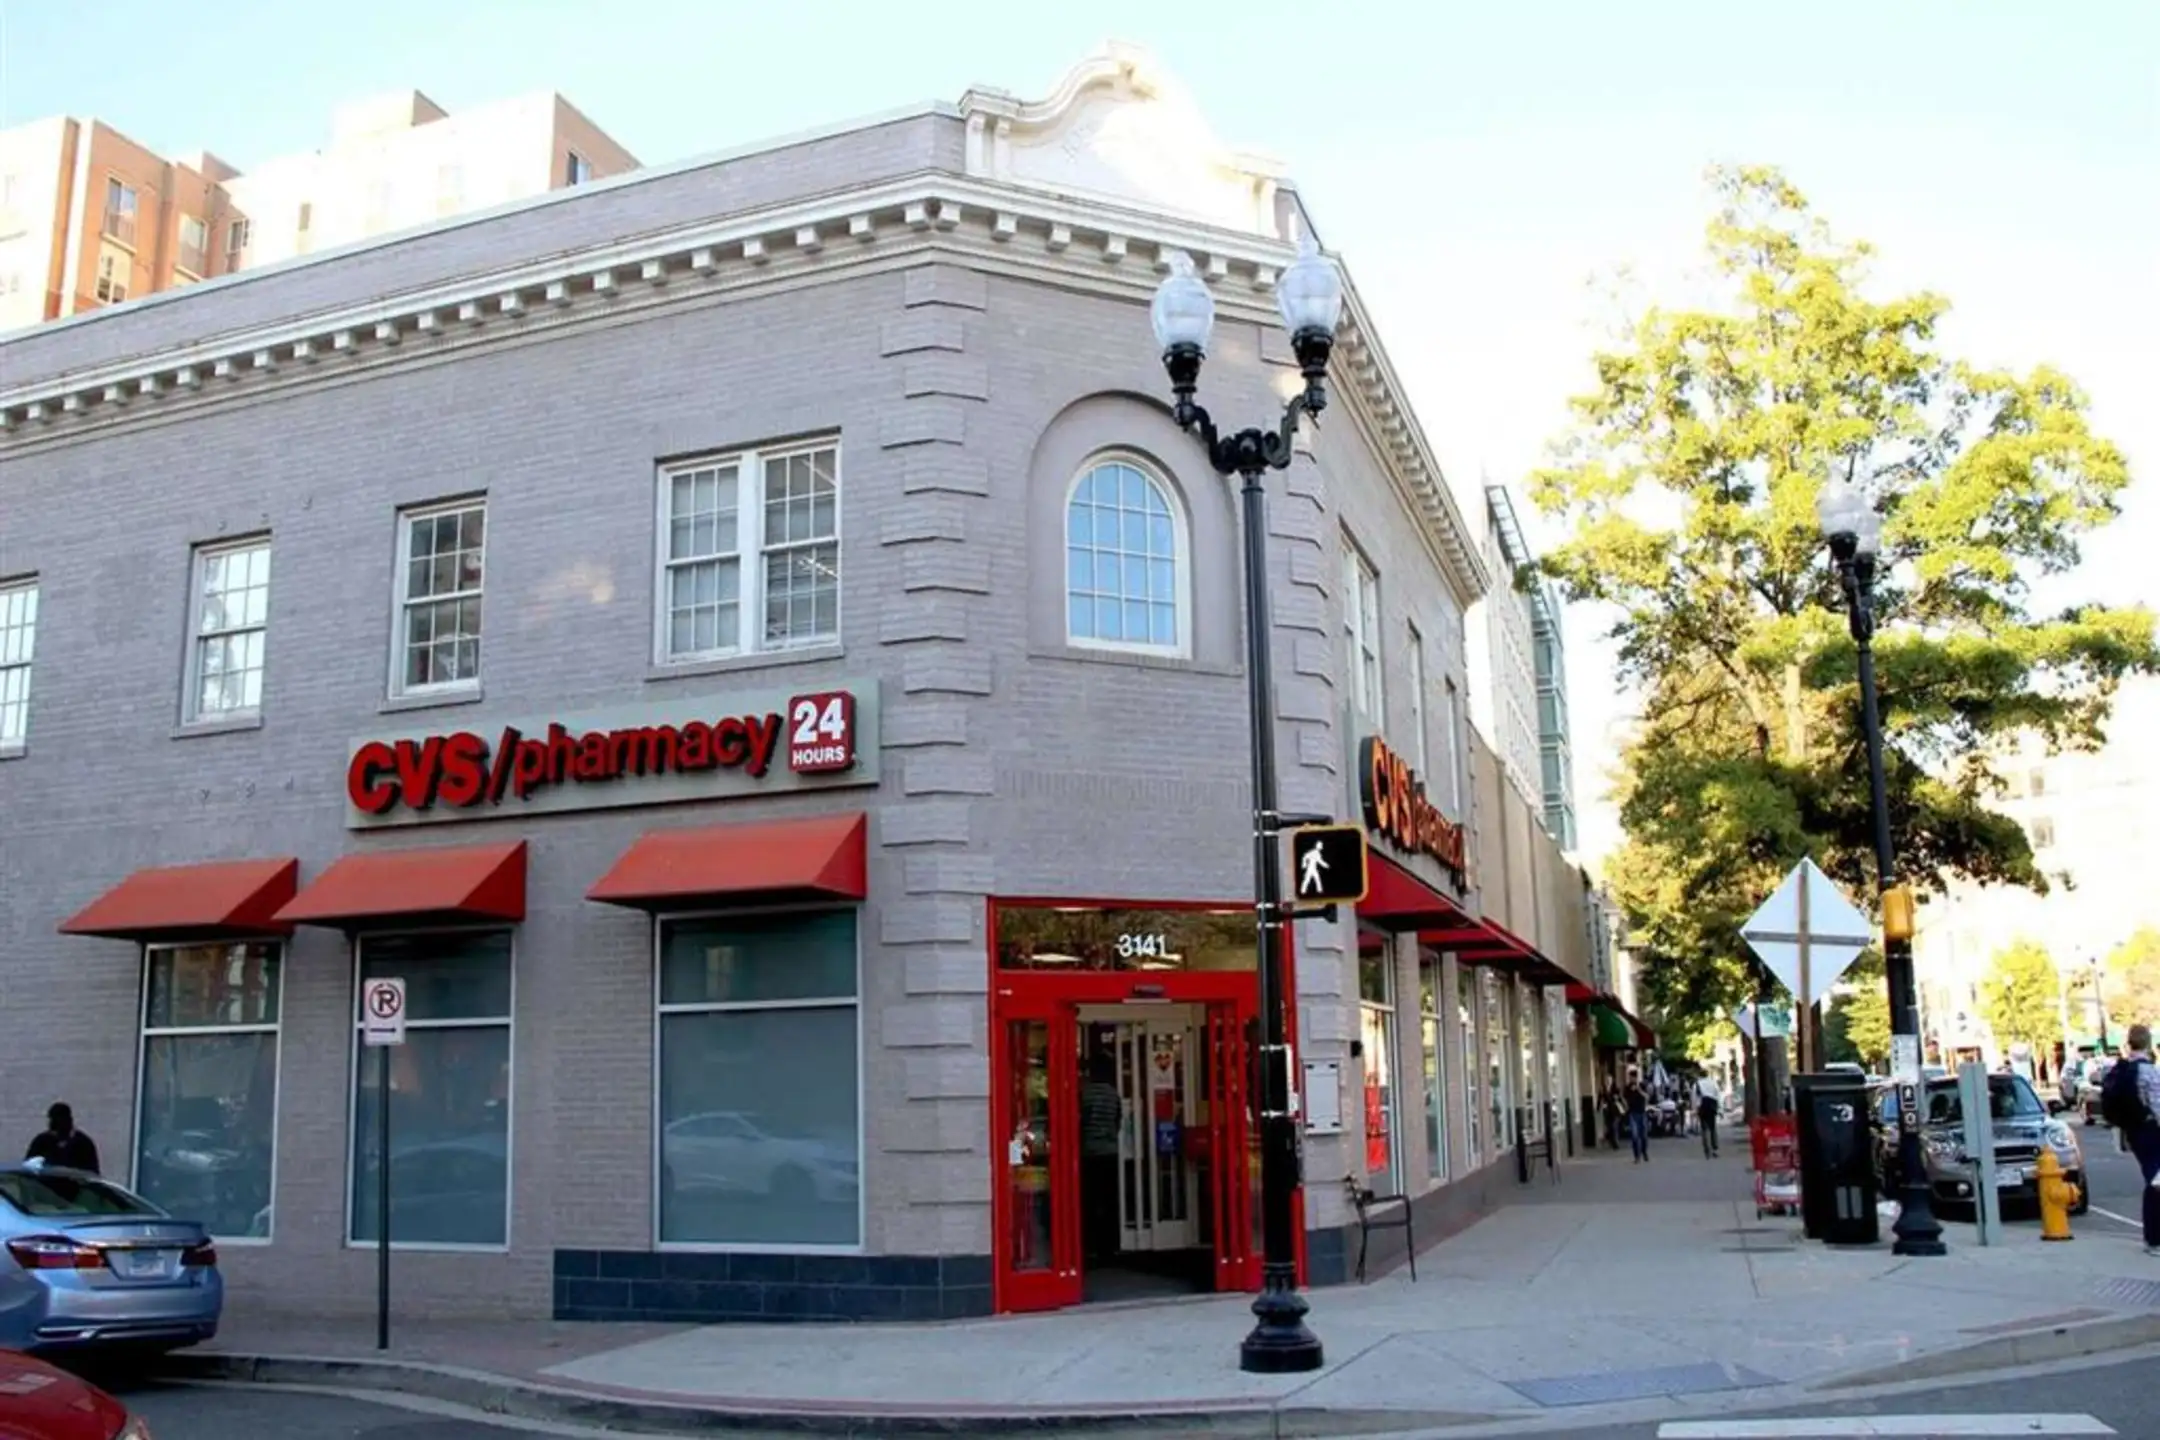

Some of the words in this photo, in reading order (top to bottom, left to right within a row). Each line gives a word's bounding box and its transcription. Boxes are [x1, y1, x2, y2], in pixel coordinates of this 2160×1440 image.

[793, 698, 845, 743] 24
[348, 712, 783, 816] CVS/pharmacy
[793, 746, 845, 766] HOURS
[1116, 933, 1166, 957] 3141
